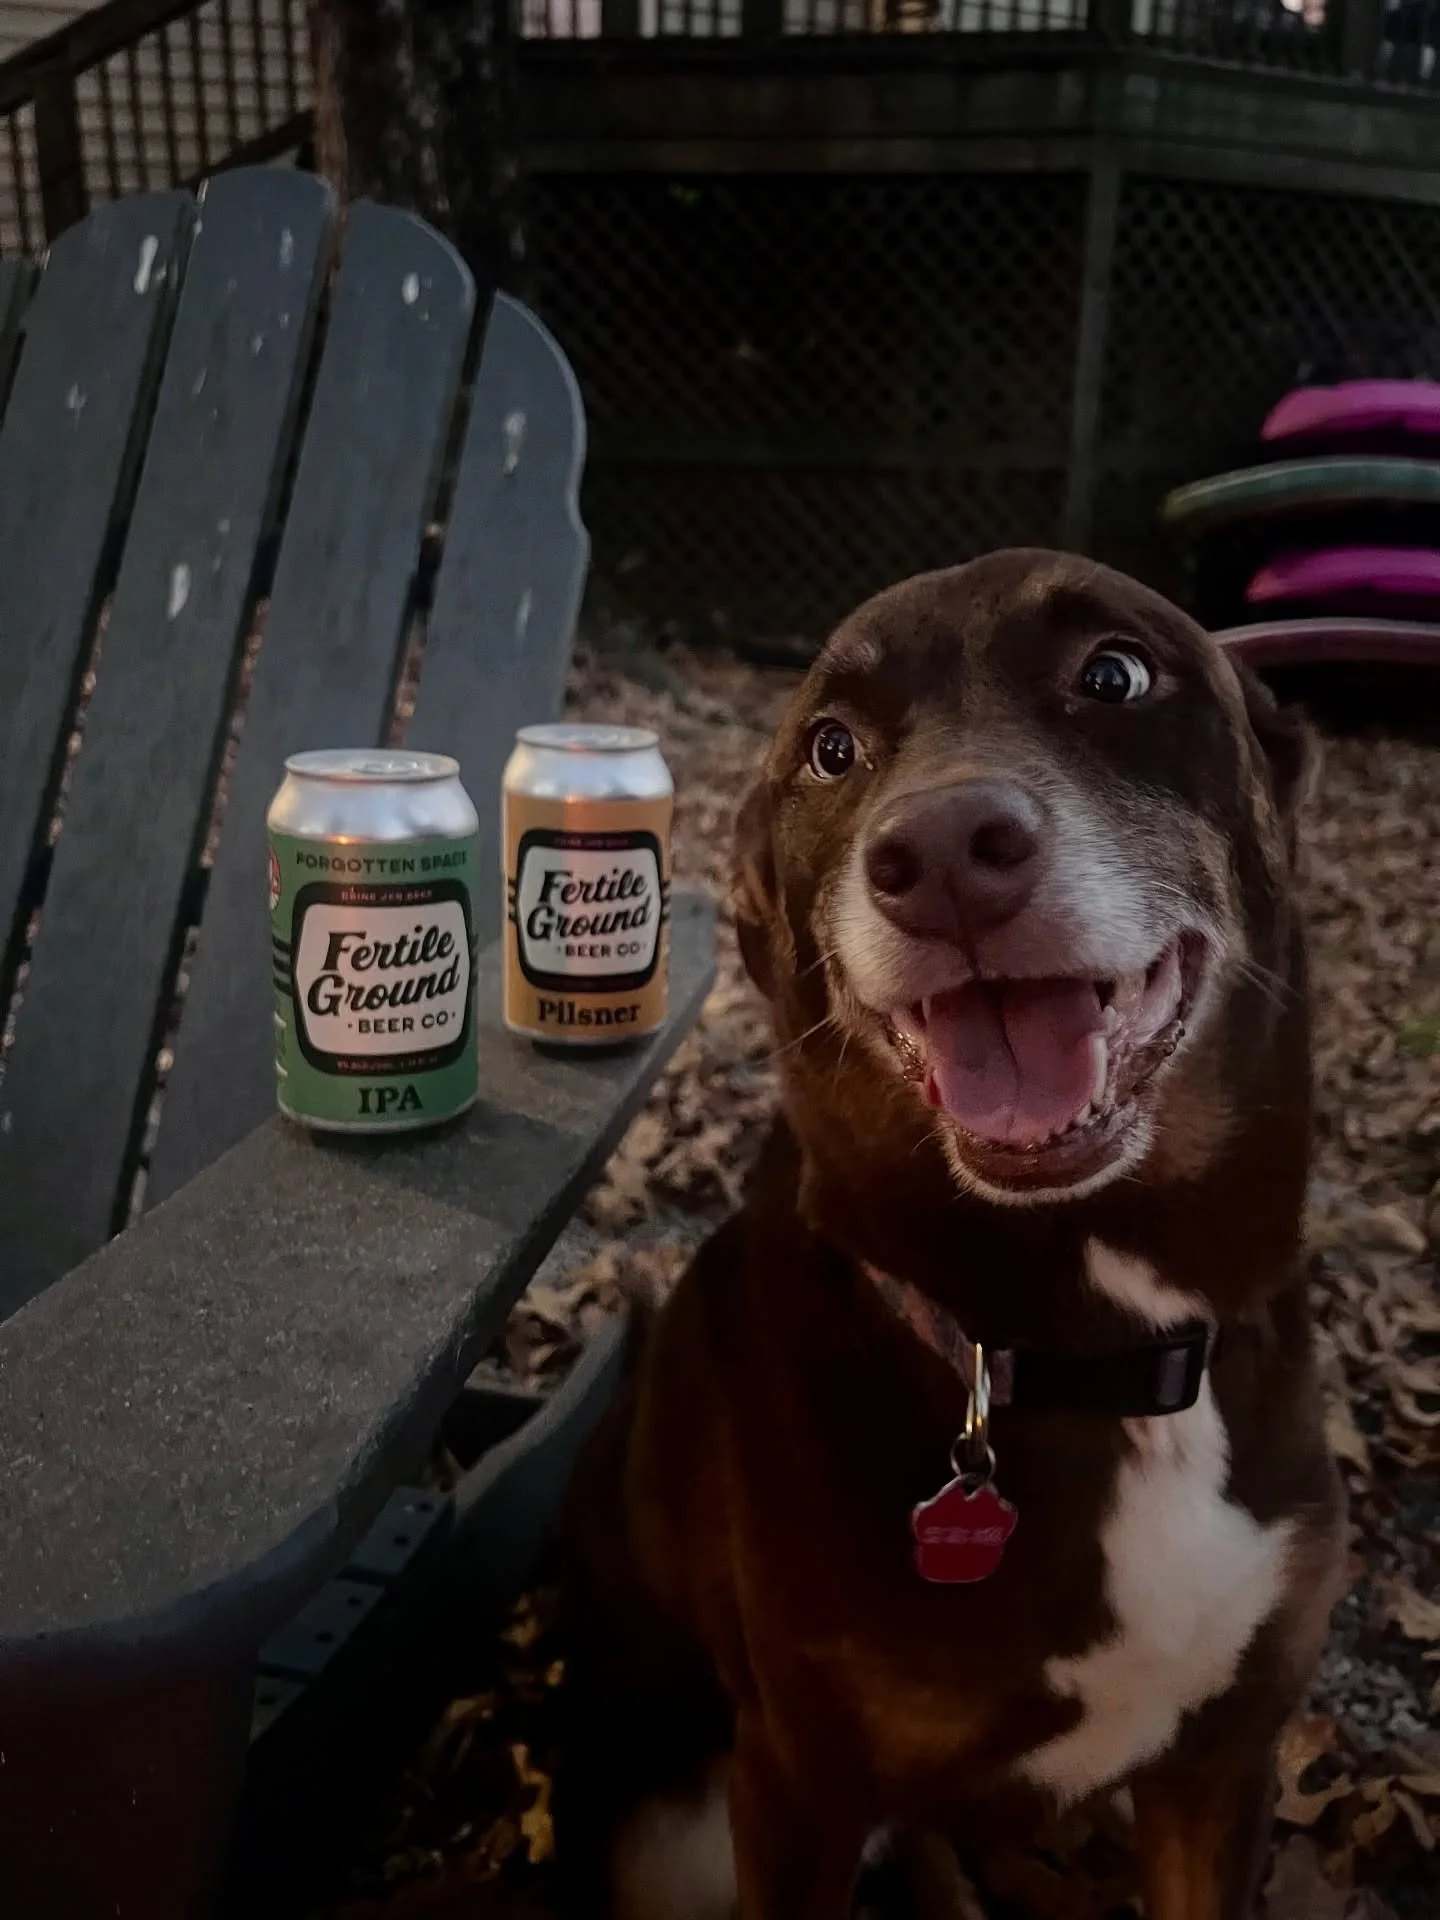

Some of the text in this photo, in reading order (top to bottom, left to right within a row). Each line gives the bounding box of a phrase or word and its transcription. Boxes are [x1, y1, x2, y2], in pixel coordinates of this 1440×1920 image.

[296, 850, 415, 873] FORGOTTEN
[539, 867, 648, 905] Fertile
[527, 895, 652, 941] Ground
[322, 925, 455, 972] Fertile
[566, 943, 611, 958] BEER
[307, 955, 461, 1017] Ground
[358, 1012, 449, 1034] BEER CO
[538, 998, 641, 1026] Pilsner
[358, 1084, 424, 1114] IPA
